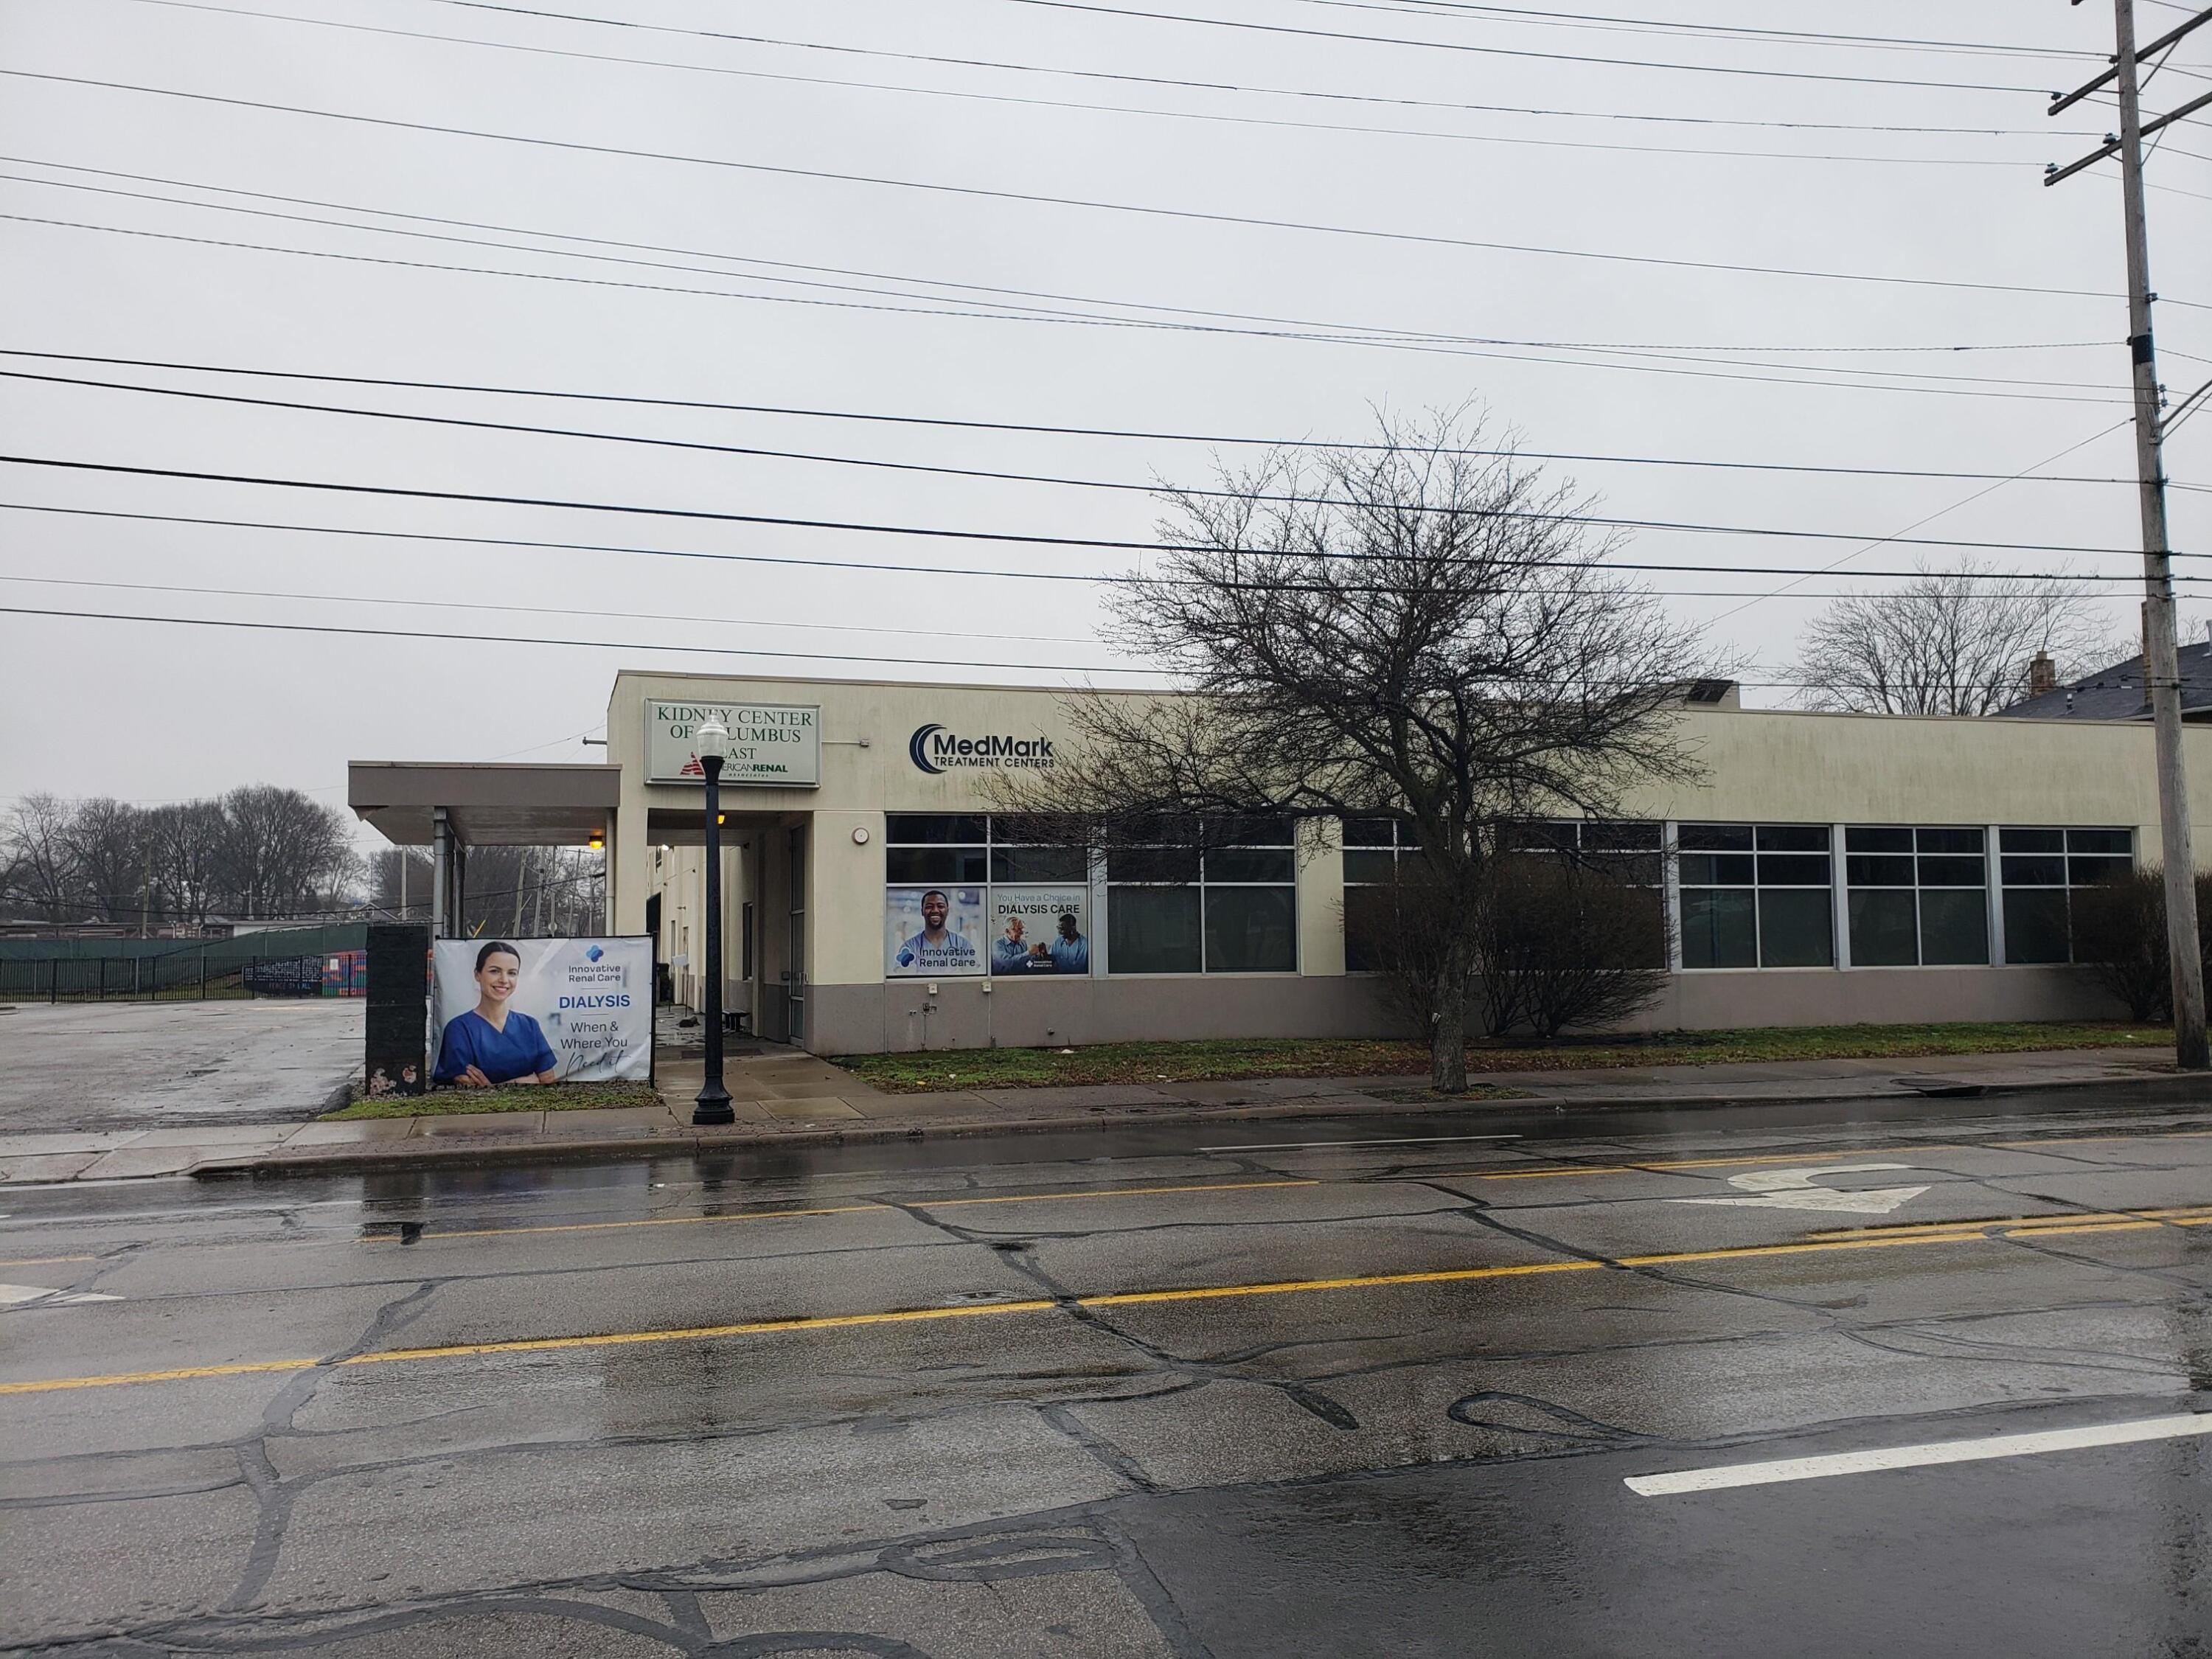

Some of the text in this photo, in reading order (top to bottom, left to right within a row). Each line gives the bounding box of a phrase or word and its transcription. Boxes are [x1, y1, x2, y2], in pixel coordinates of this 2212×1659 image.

[737, 709, 813, 726] CENTER
[669, 724, 801, 743] OF LUMBUS
[933, 734, 1054, 757] MedMark
[723, 747, 757, 759] AST
[933, 757, 1055, 768] TREATMENT CENTERS
[997, 894, 1013, 902] You
[1014, 893, 1035, 902] Have
[1043, 893, 1072, 902] Choice
[998, 904, 1080, 914] DIALYSIS CARE
[919, 946, 976, 957] Innovative
[568, 964, 621, 973] Innovative
[919, 958, 976, 967] Renal Care
[568, 973, 621, 983] Renal Care
[559, 995, 630, 1009] DIALYSIS
[570, 1020, 619, 1033] When &
[560, 1037, 628, 1049] Where You
[566, 1049, 631, 1077] Need it
